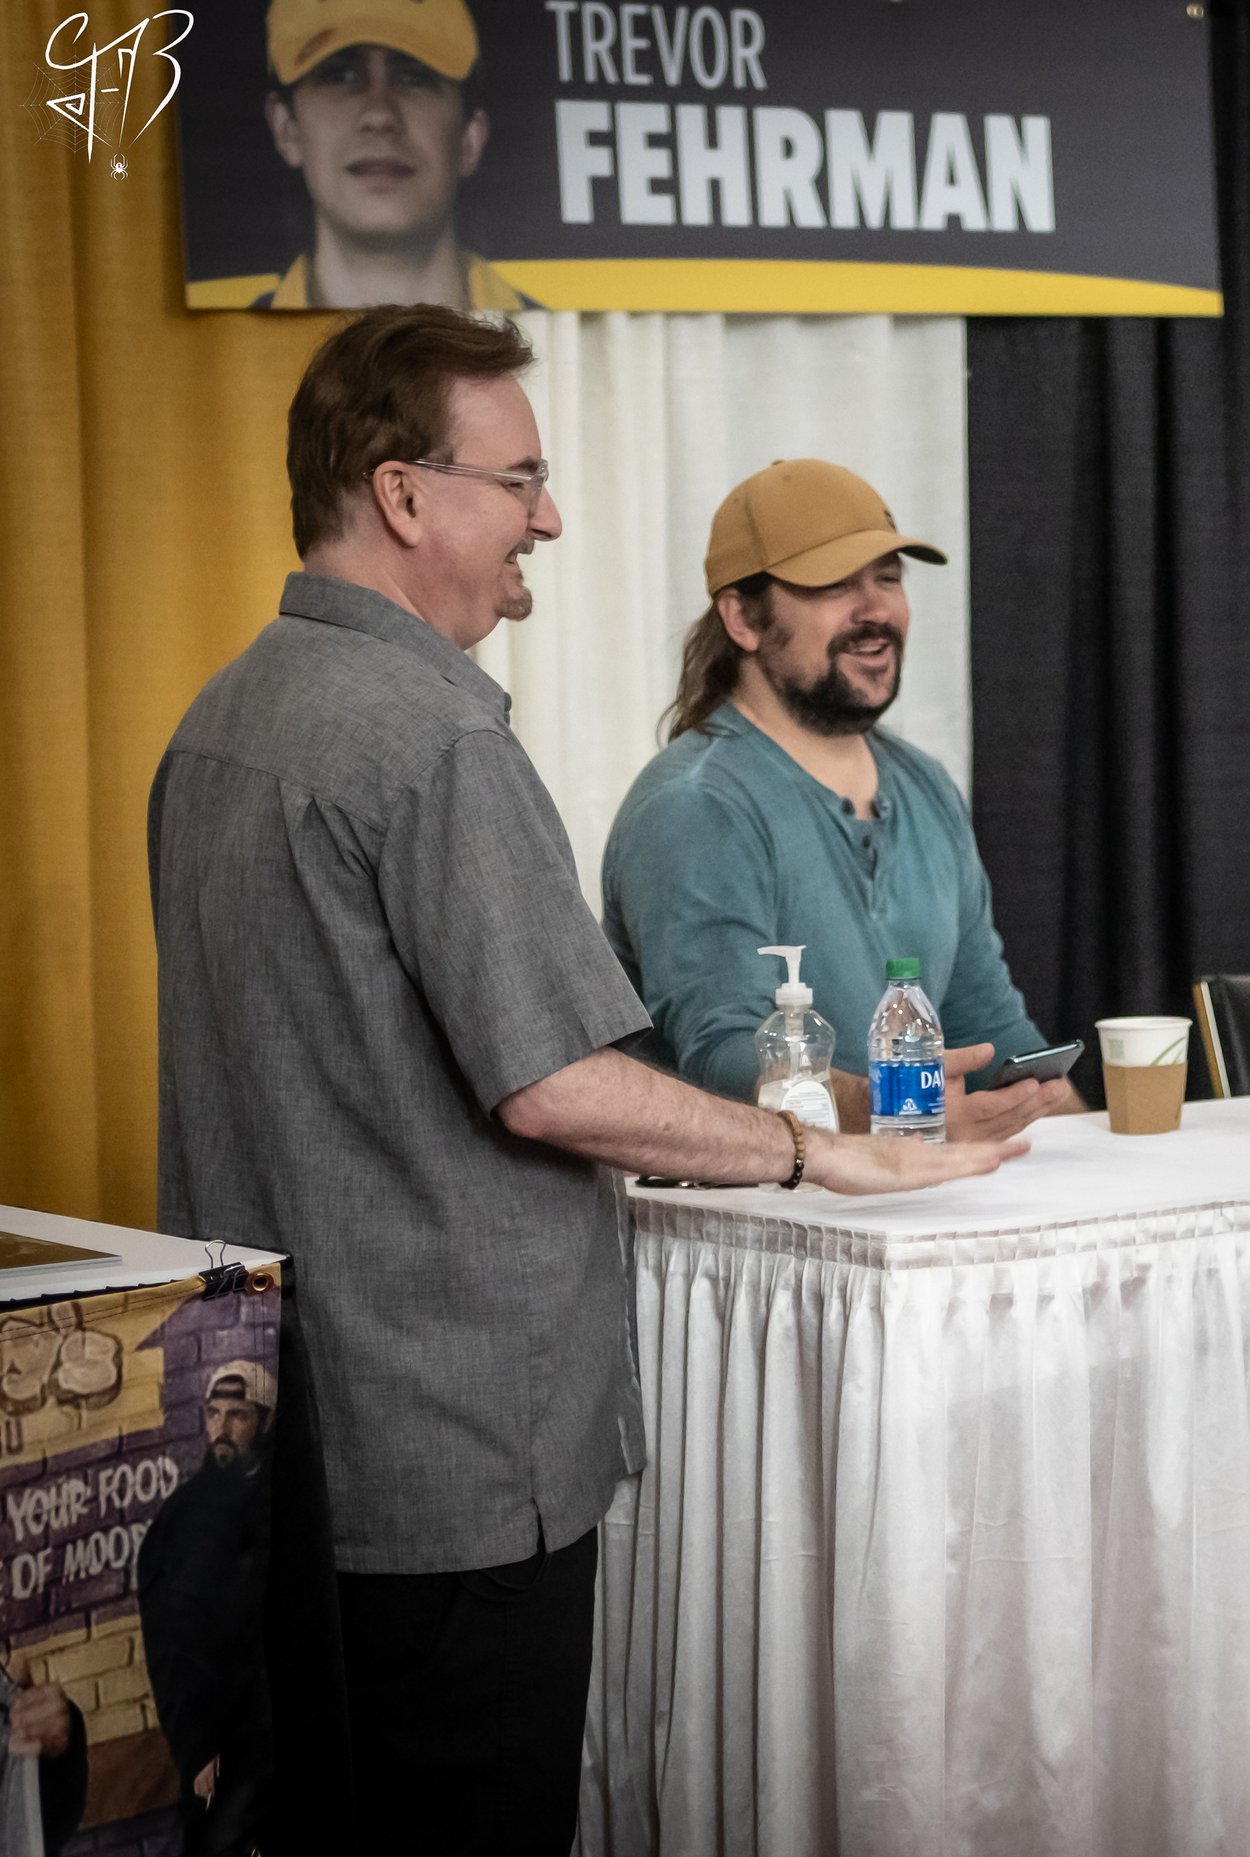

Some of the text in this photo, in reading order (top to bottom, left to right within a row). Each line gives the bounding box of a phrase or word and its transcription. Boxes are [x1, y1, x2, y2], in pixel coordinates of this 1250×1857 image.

[545, 1, 768, 90] TREVOR
[555, 100, 1056, 234] FEHRMAN
[7, 1456, 179, 1542] YOUR FOOD
[12, 1548, 52, 1599] OF
